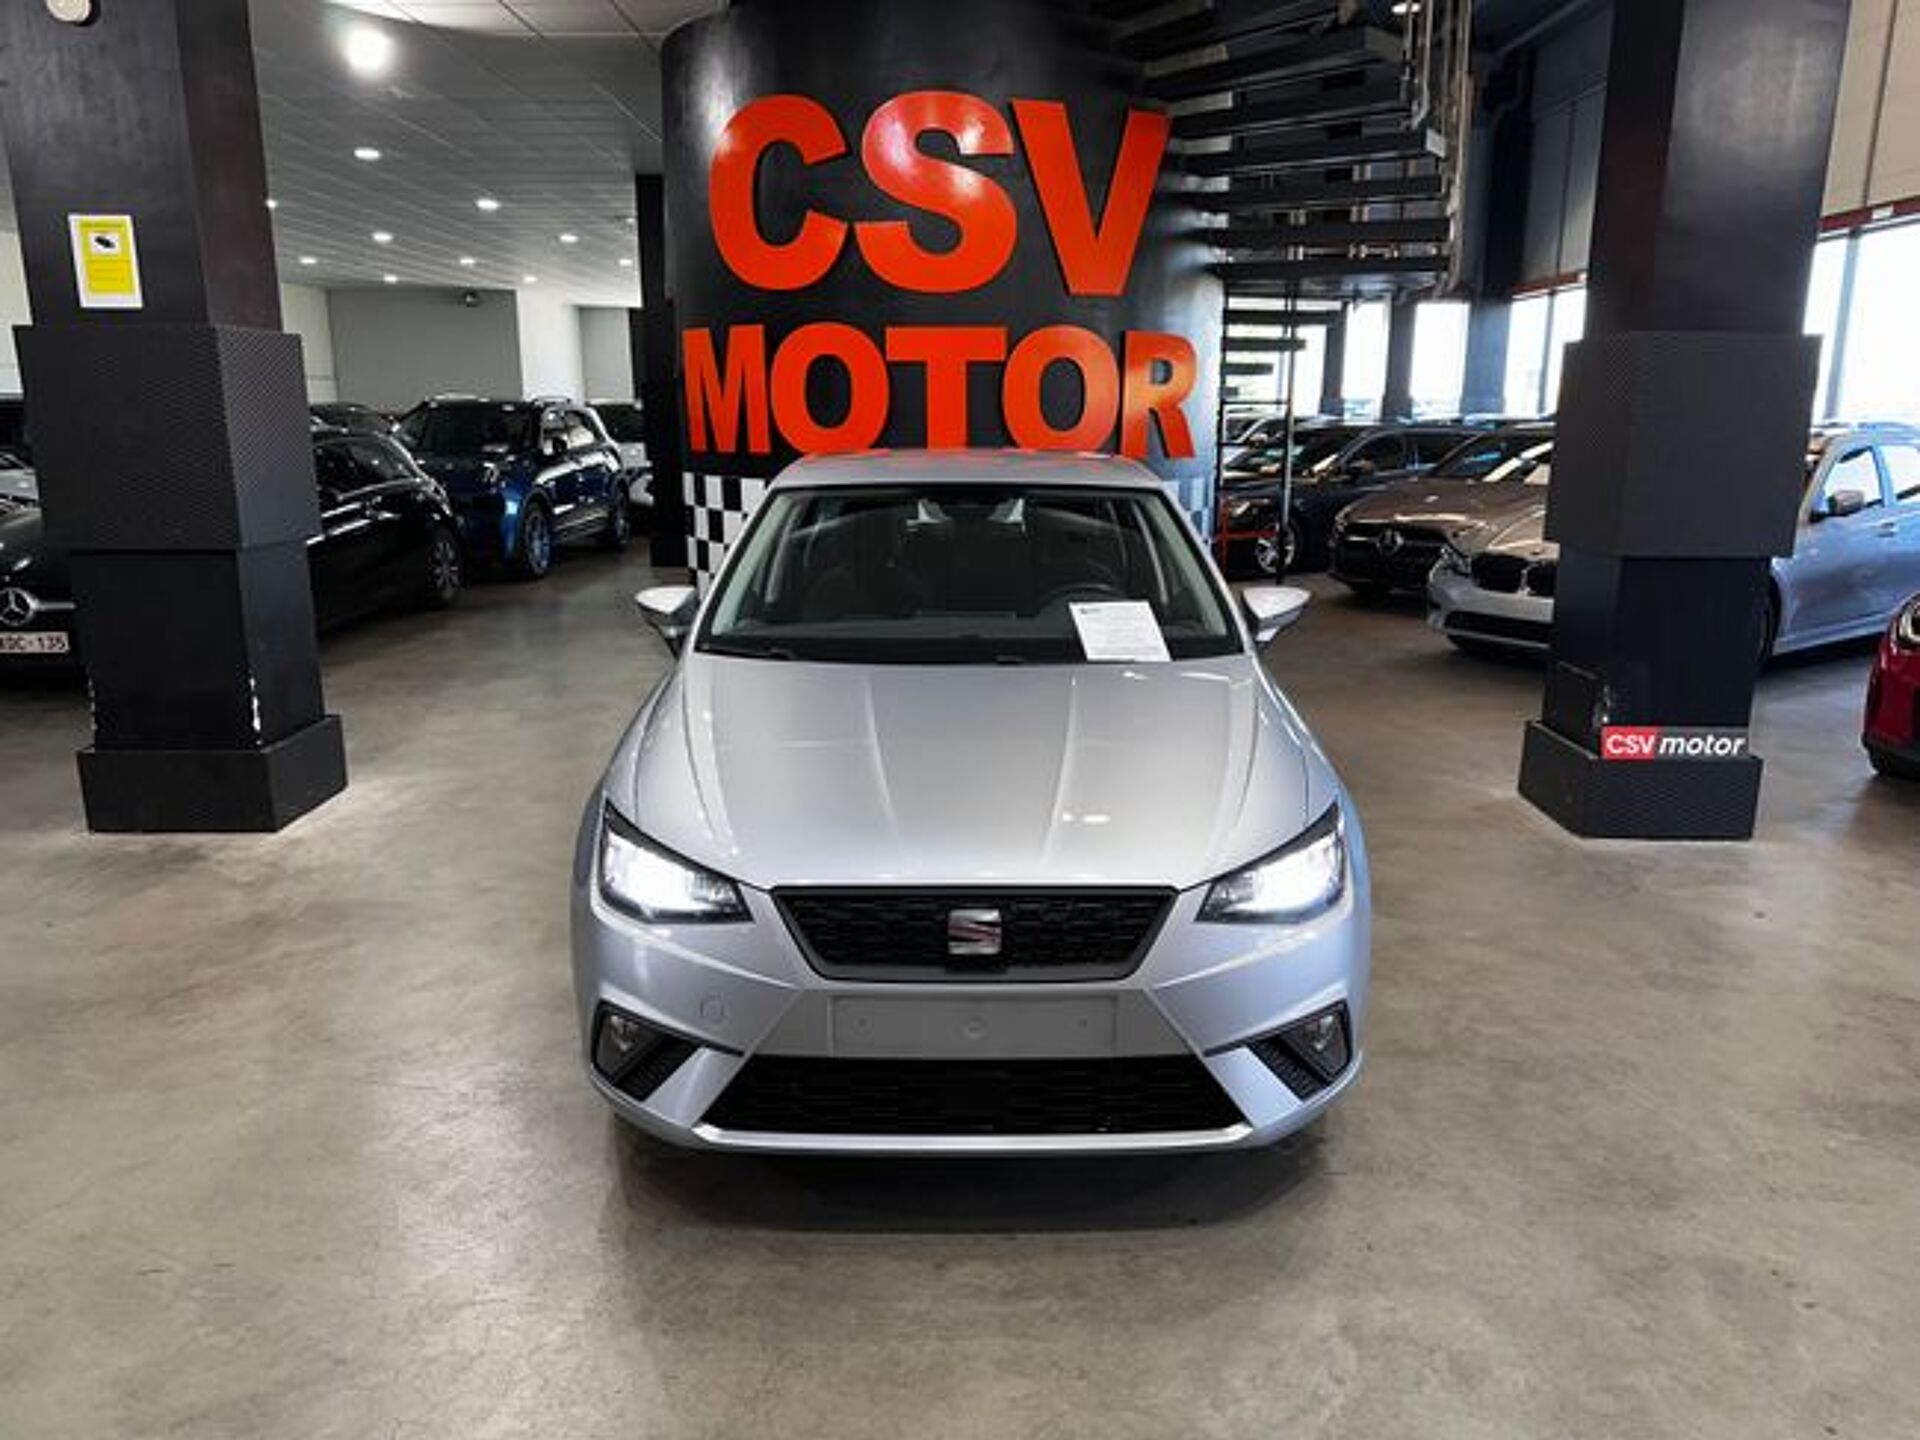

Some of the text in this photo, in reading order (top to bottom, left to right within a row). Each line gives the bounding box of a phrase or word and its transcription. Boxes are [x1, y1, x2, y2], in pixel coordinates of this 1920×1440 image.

[709, 91, 1172, 296] CSV
[682, 322, 1197, 458] MOTOR
[1606, 733, 1745, 755] CSV motor
